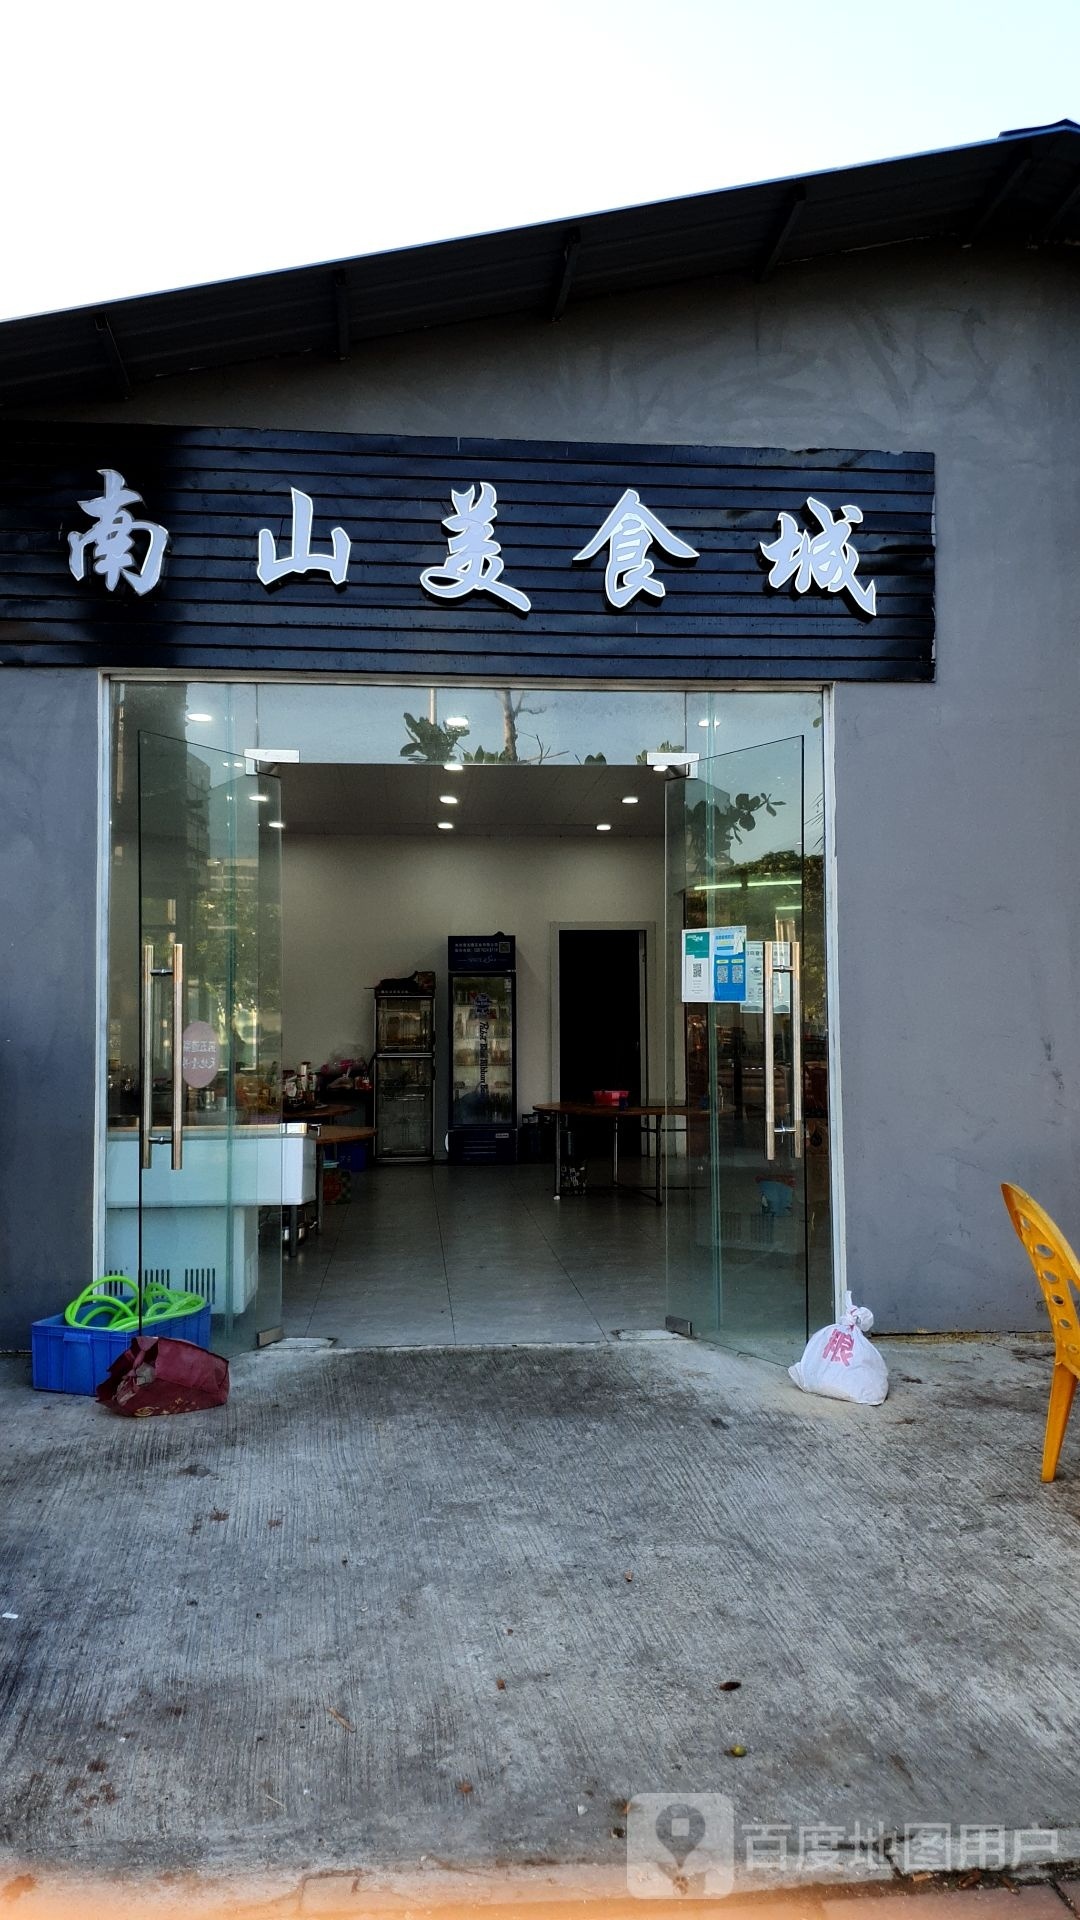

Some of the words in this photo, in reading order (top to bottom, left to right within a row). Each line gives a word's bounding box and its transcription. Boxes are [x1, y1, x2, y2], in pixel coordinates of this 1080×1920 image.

[69, 468, 877, 617] 南山美食城
